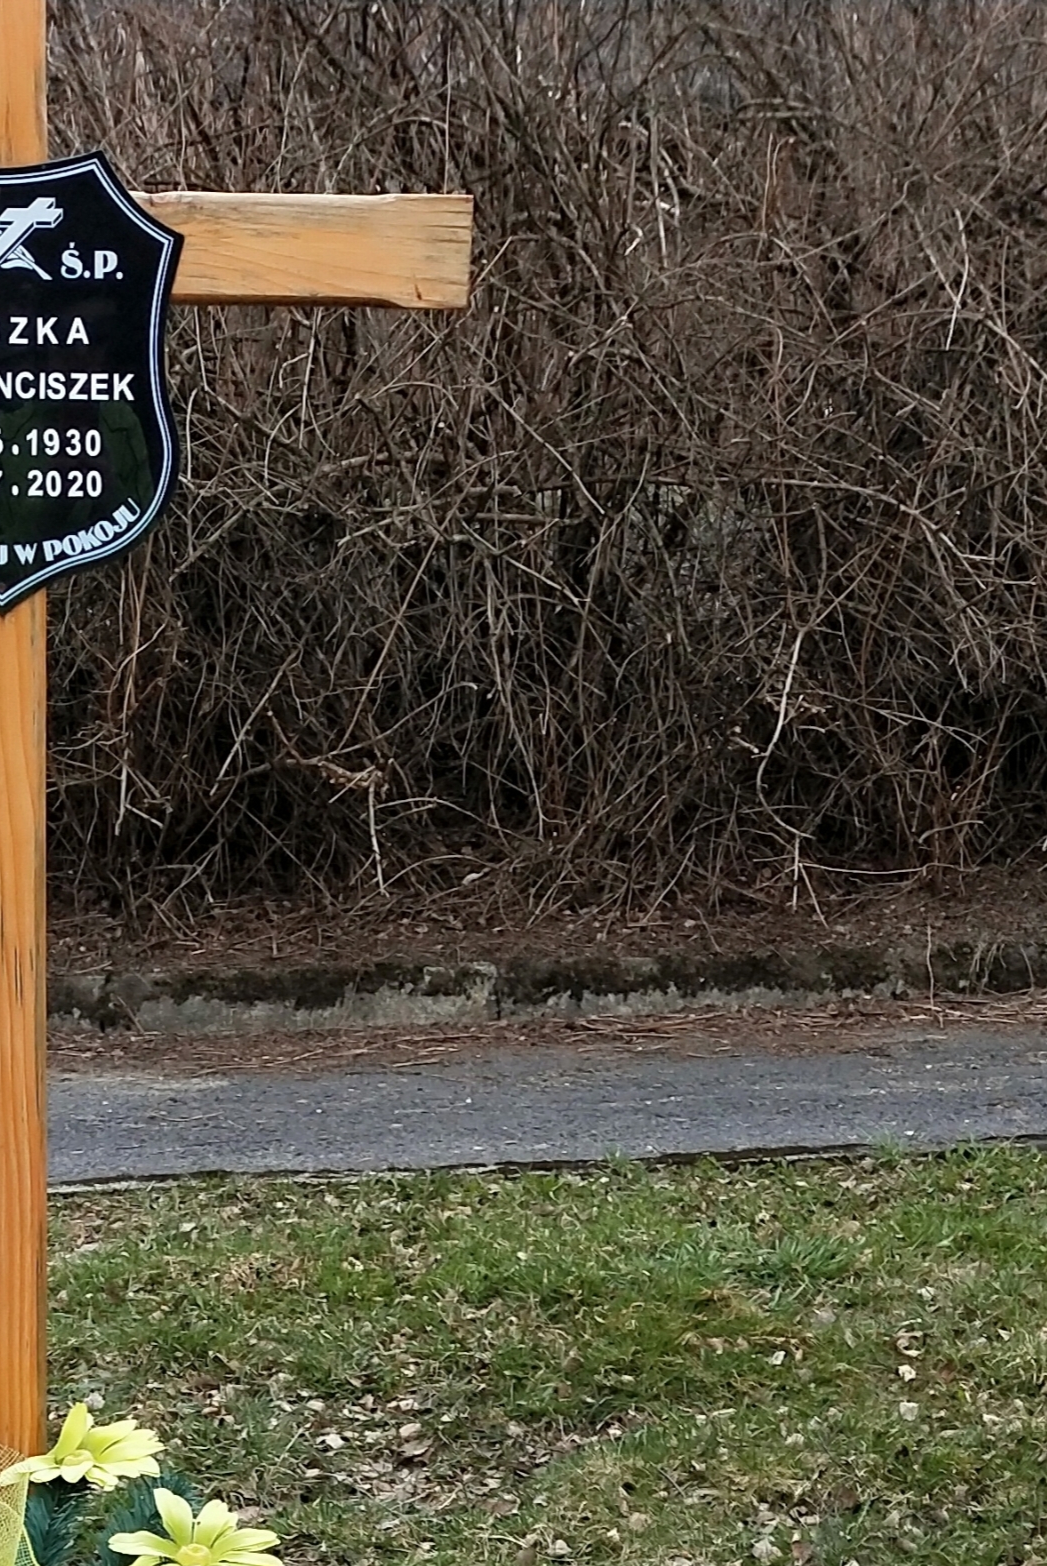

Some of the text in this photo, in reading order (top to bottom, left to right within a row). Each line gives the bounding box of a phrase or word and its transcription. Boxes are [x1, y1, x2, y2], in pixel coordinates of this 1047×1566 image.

[60, 242, 124, 280] Ś.P.
[13, 541, 38, 565] W
[42, 497, 142, 562] POKOJU
